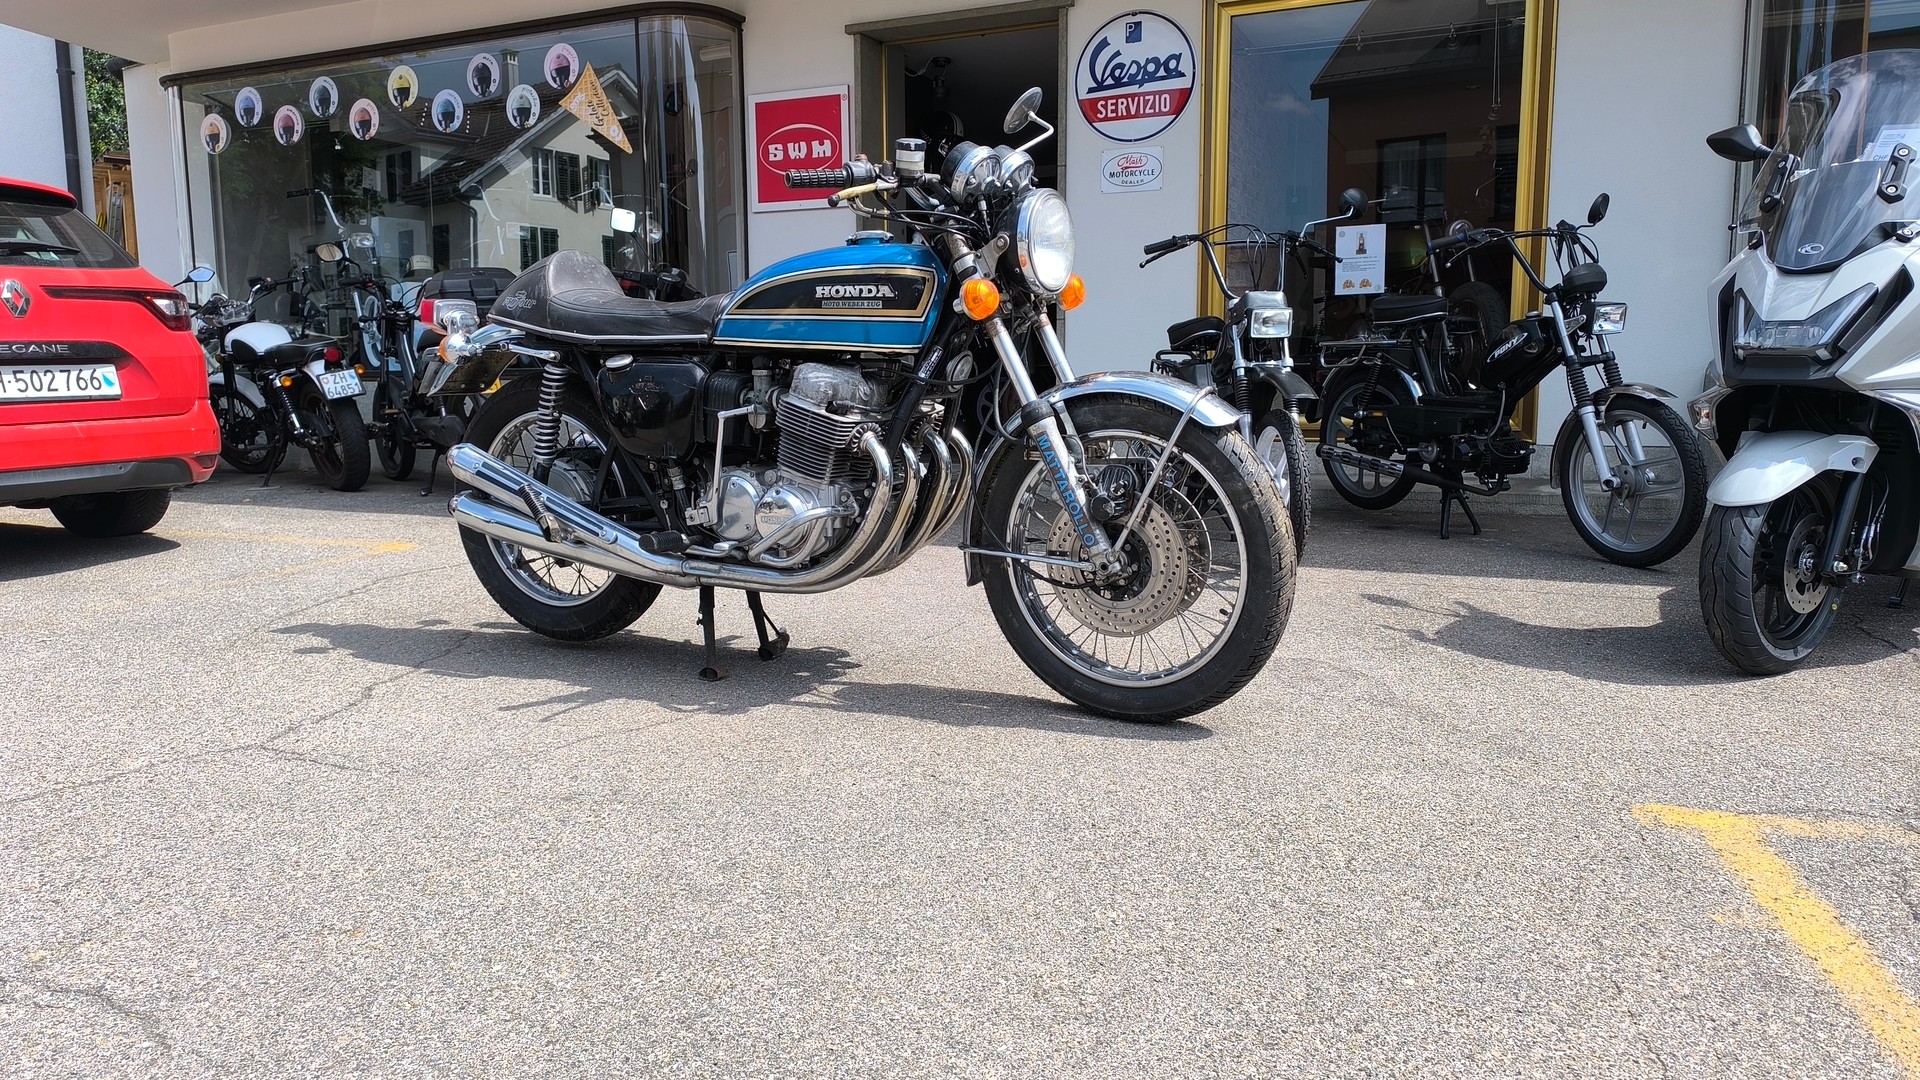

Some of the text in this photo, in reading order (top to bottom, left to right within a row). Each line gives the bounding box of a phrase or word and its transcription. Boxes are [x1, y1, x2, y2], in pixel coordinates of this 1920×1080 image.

[1126, 23, 1135, 37] P
[1086, 36, 1187, 94] Vespa
[1096, 93, 1170, 119] SERVIZIO
[768, 139, 832, 161] SWM
[1109, 168, 1156, 179] MOTORCYCLE
[815, 284, 895, 298] HONDA
[1494, 335, 1519, 359] PONY
[330, 372, 348, 385] ZH
[328, 382, 362, 398] 64851
[1036, 433, 1096, 548] MATTAROLLO
